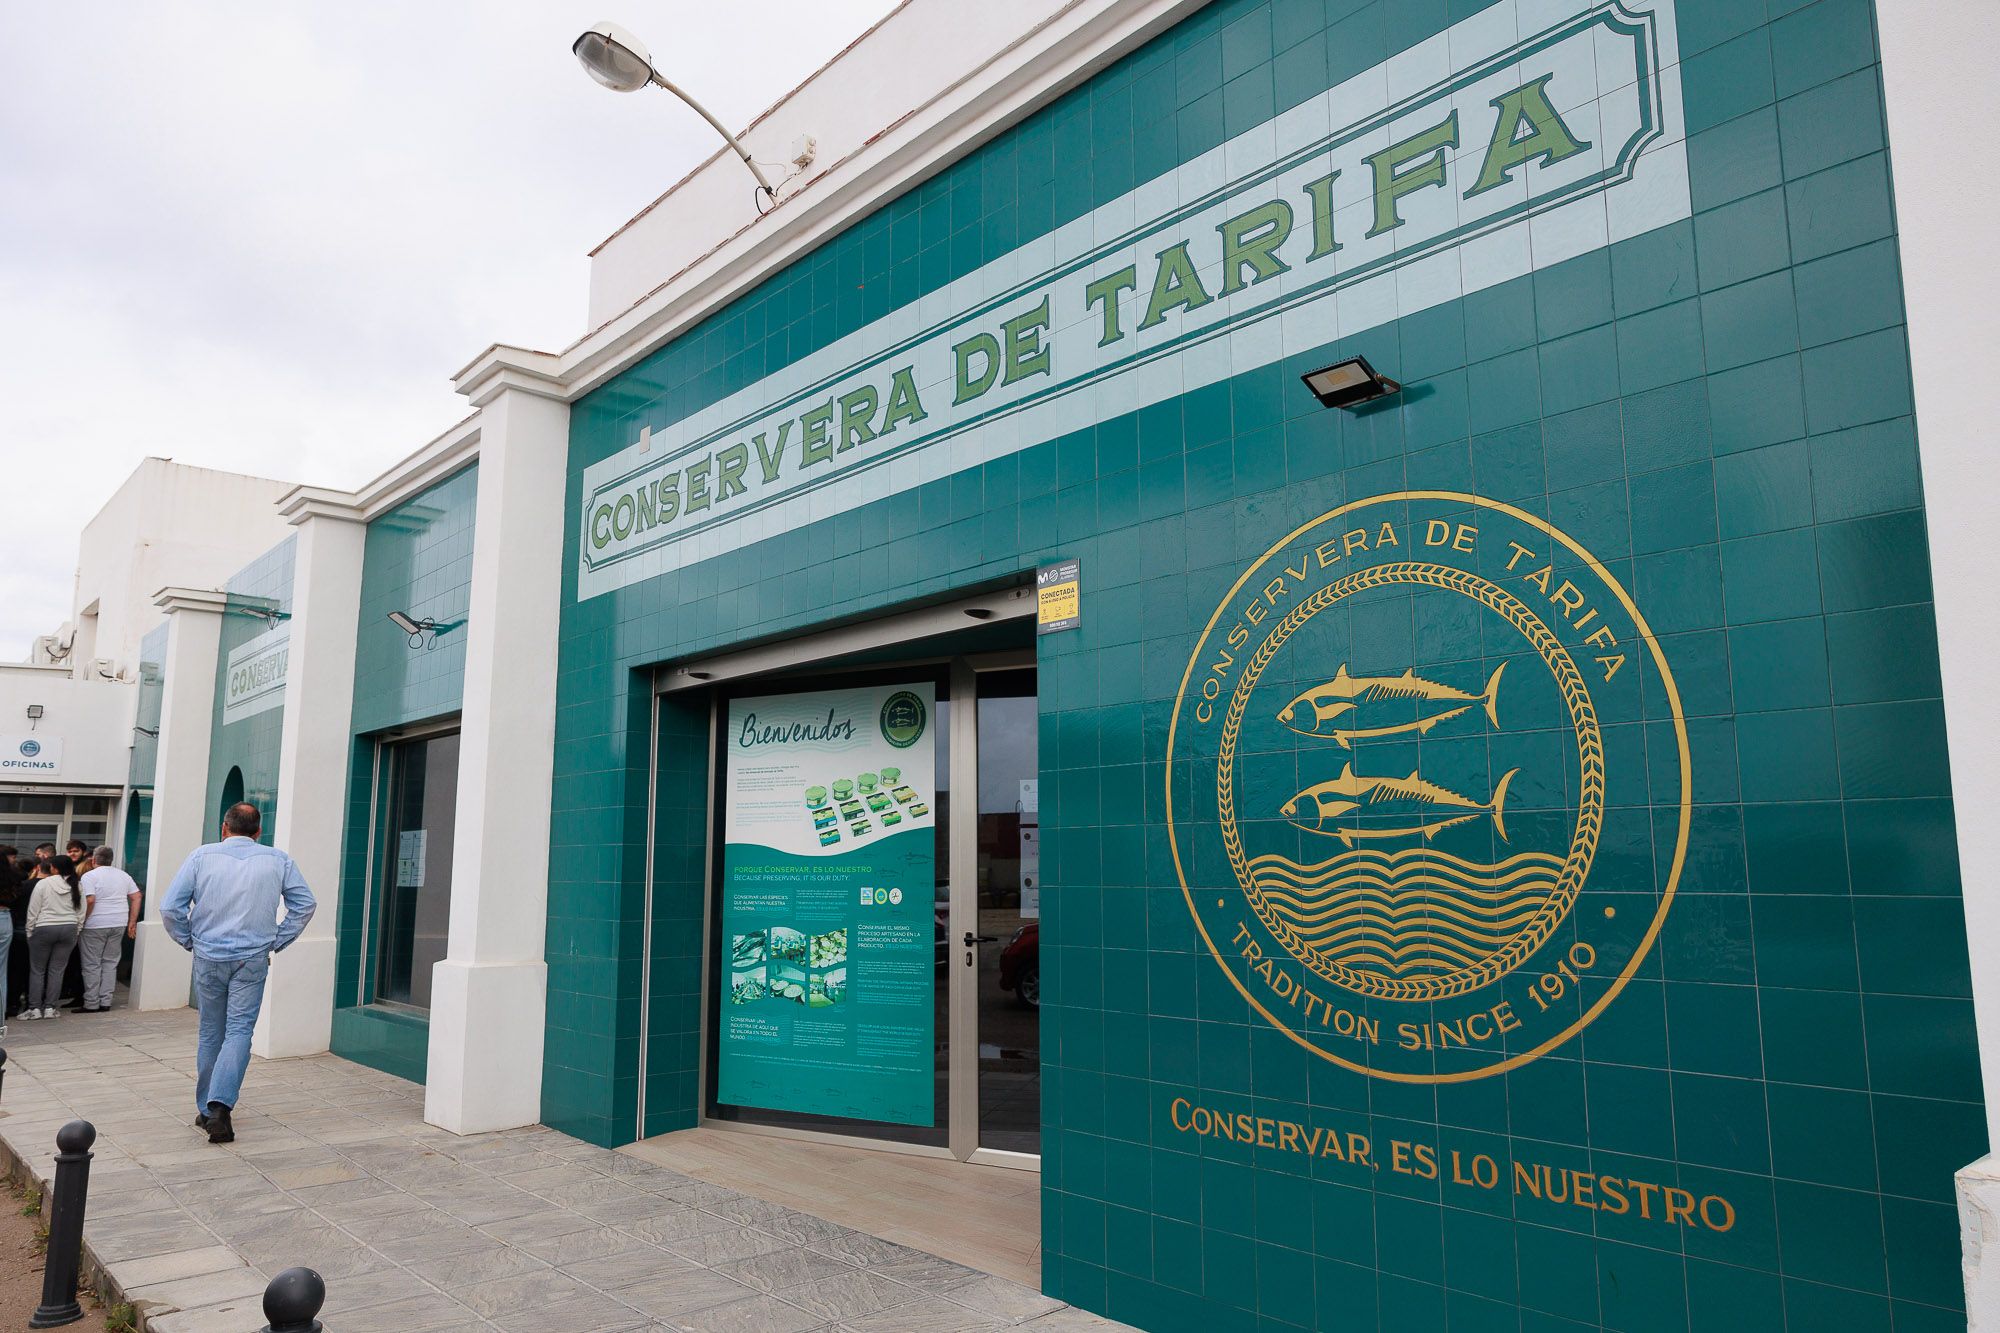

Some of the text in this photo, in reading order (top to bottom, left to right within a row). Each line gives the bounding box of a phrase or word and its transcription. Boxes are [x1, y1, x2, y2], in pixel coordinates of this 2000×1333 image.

[591, 72, 1592, 549] CONSERVERA DE TARIFA
[1041, 587, 1075, 599] CONECTADA
[1196, 520, 1626, 723] CONSERVERA DE TARIFA
[2, 760, 55, 769] OFICINAS
[739, 708, 856, 748] Bienvenidos
[1231, 921, 1596, 1051] TRADITION SINCE 1910
[1171, 1097, 1736, 1233] CONSERVAR, ES LO NUESTRO
